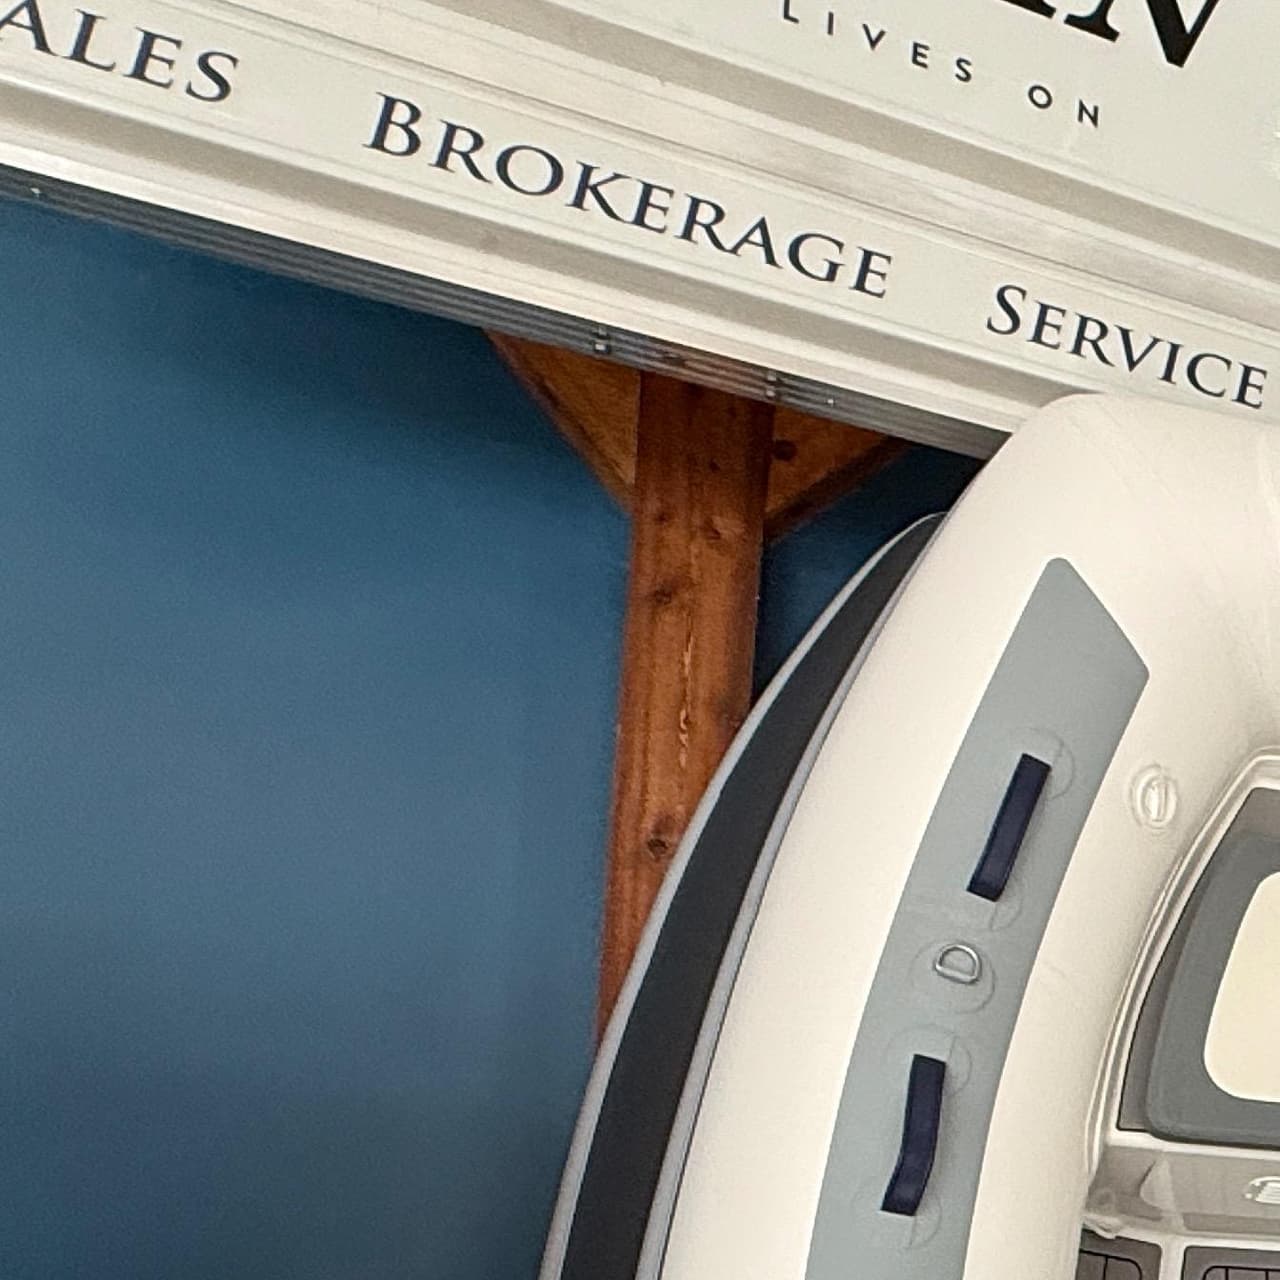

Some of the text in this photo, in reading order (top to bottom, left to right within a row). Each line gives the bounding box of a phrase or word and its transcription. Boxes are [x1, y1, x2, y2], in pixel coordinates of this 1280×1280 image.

[782, 0, 973, 83] LIVES
[1027, 84, 1099, 128] ON
[0, 0, 1268, 409] ALES BROKERAGE SERVICE
